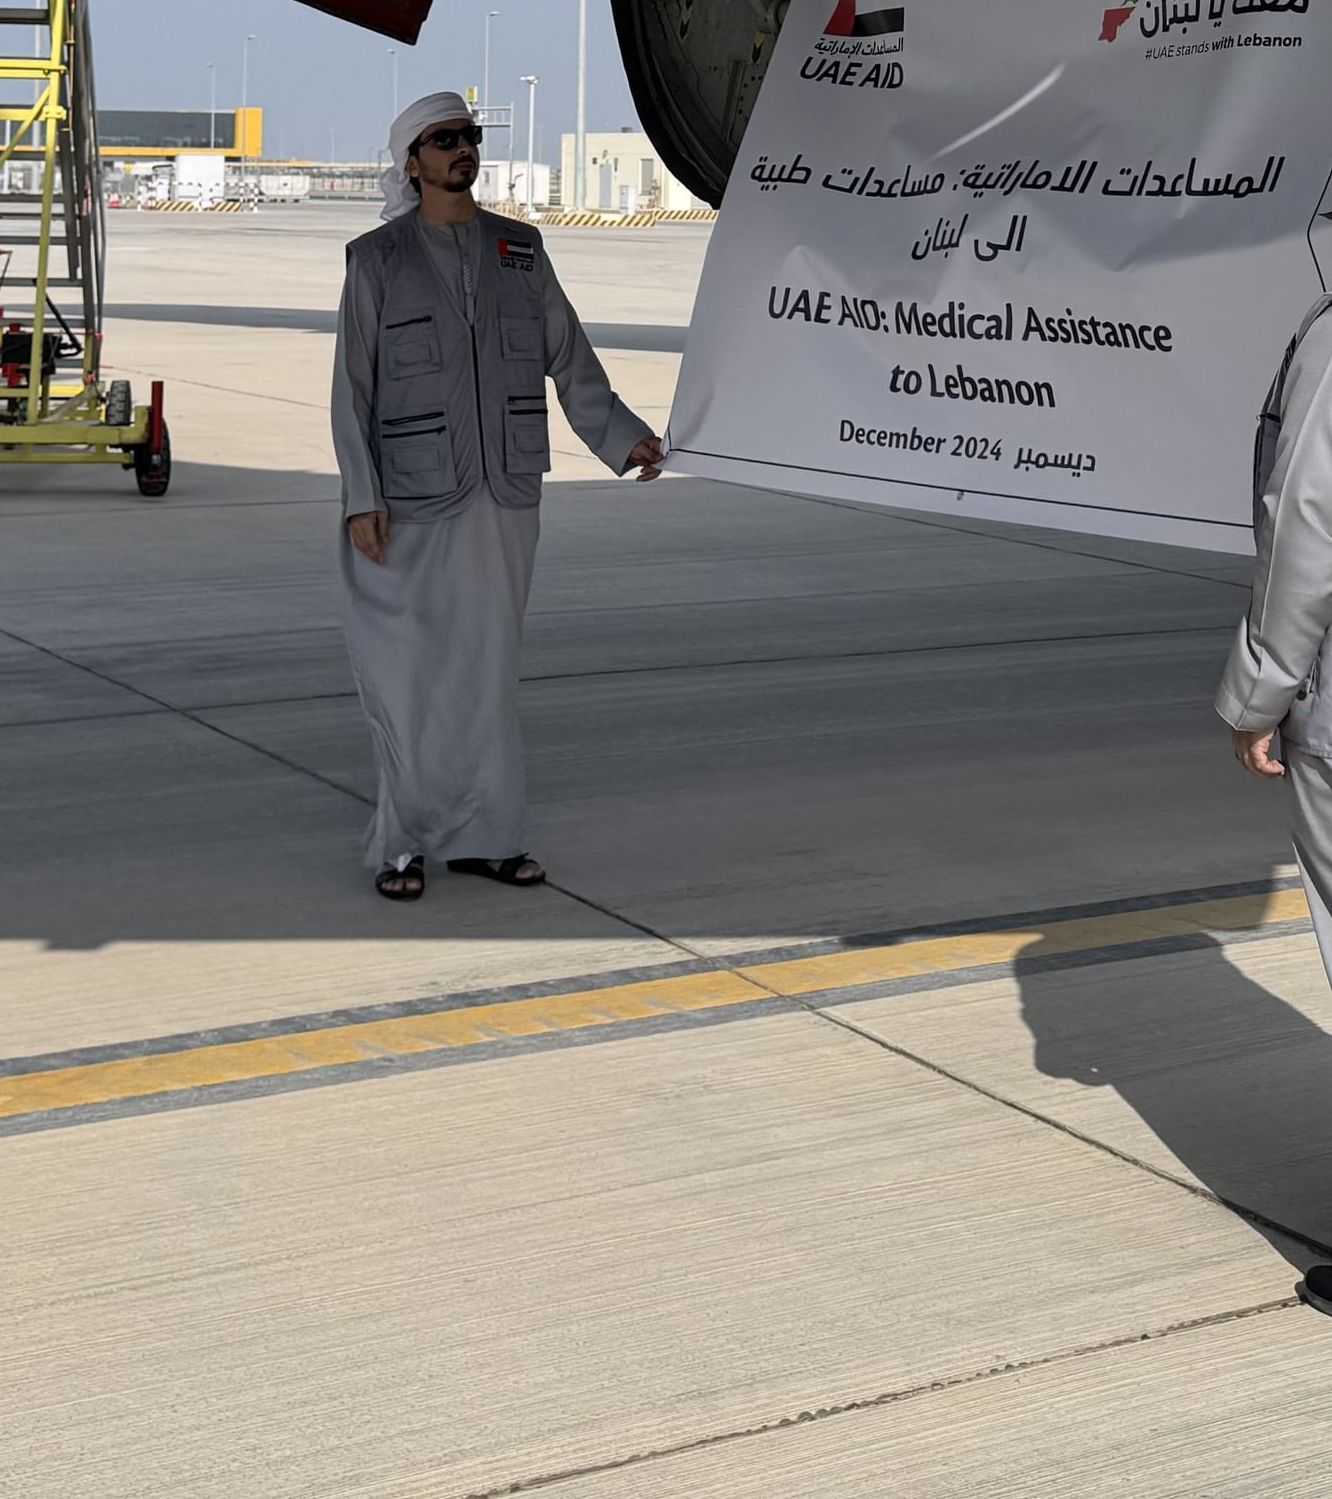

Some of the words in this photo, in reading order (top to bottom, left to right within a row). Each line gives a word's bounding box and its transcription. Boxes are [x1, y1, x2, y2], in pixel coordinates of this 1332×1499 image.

[861, 37, 904, 56] المساعدات
[1145, 45, 1174, 60] #UAE
[1175, 40, 1210, 57] stands
[1212, 34, 1235, 51] with
[1237, 33, 1302, 48] Lebanon
[800, 56, 863, 87] UAE
[858, 61, 904, 89] AID
[750, 154, 813, 192] طبية
[821, 164, 946, 198] مساعدات
[1101, 156, 1286, 198] المساعدات
[911, 213, 970, 260] لبنان
[973, 215, 1028, 262] الى
[768, 286, 833, 325] UAE
[838, 295, 890, 333] AID:
[894, 301, 1013, 341] Medical
[1022, 307, 1173, 352] Assistance
[889, 364, 922, 395] to
[927, 363, 1056, 408] Lebanon
[839, 419, 947, 454] December
[950, 435, 1003, 462] 2024
[1013, 447, 1096, 478] ديسمبر
